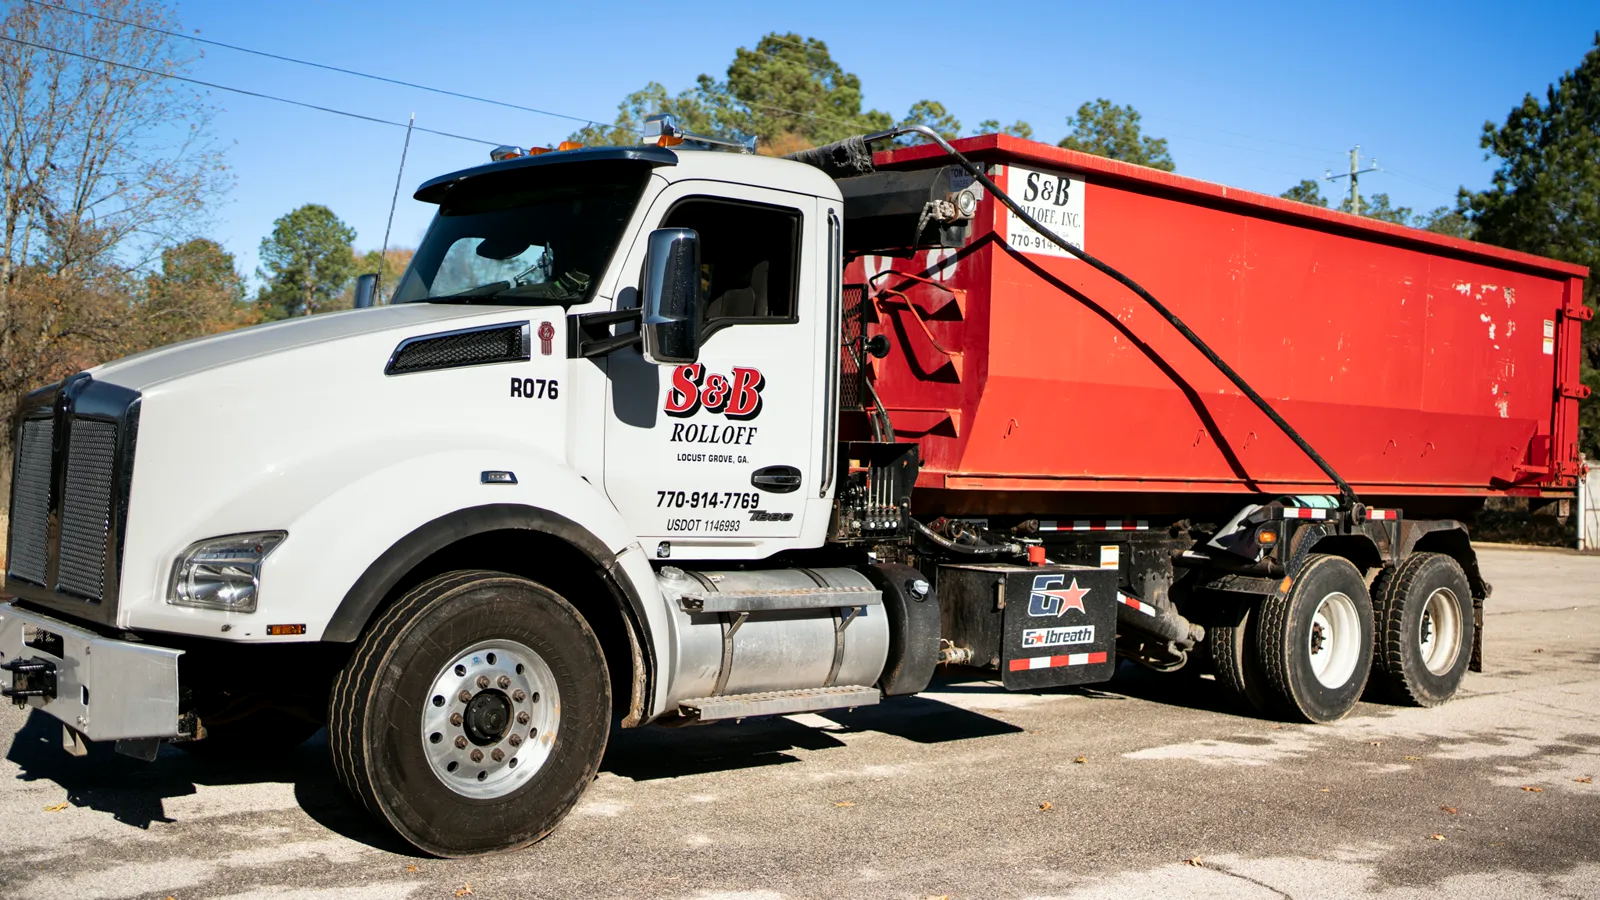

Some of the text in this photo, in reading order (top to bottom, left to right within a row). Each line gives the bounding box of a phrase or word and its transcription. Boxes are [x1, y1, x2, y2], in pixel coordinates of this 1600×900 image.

[1023, 172, 1071, 207] S&B
[1061, 211, 1081, 228] INC.
[664, 362, 766, 421] S&B
[670, 423, 758, 446] ROLLOFF
[677, 453, 750, 465] LOCUST GROVE, GA.
[656, 491, 760, 510] 770-914-7769
[666, 518, 741, 533] USDOT 1146993
